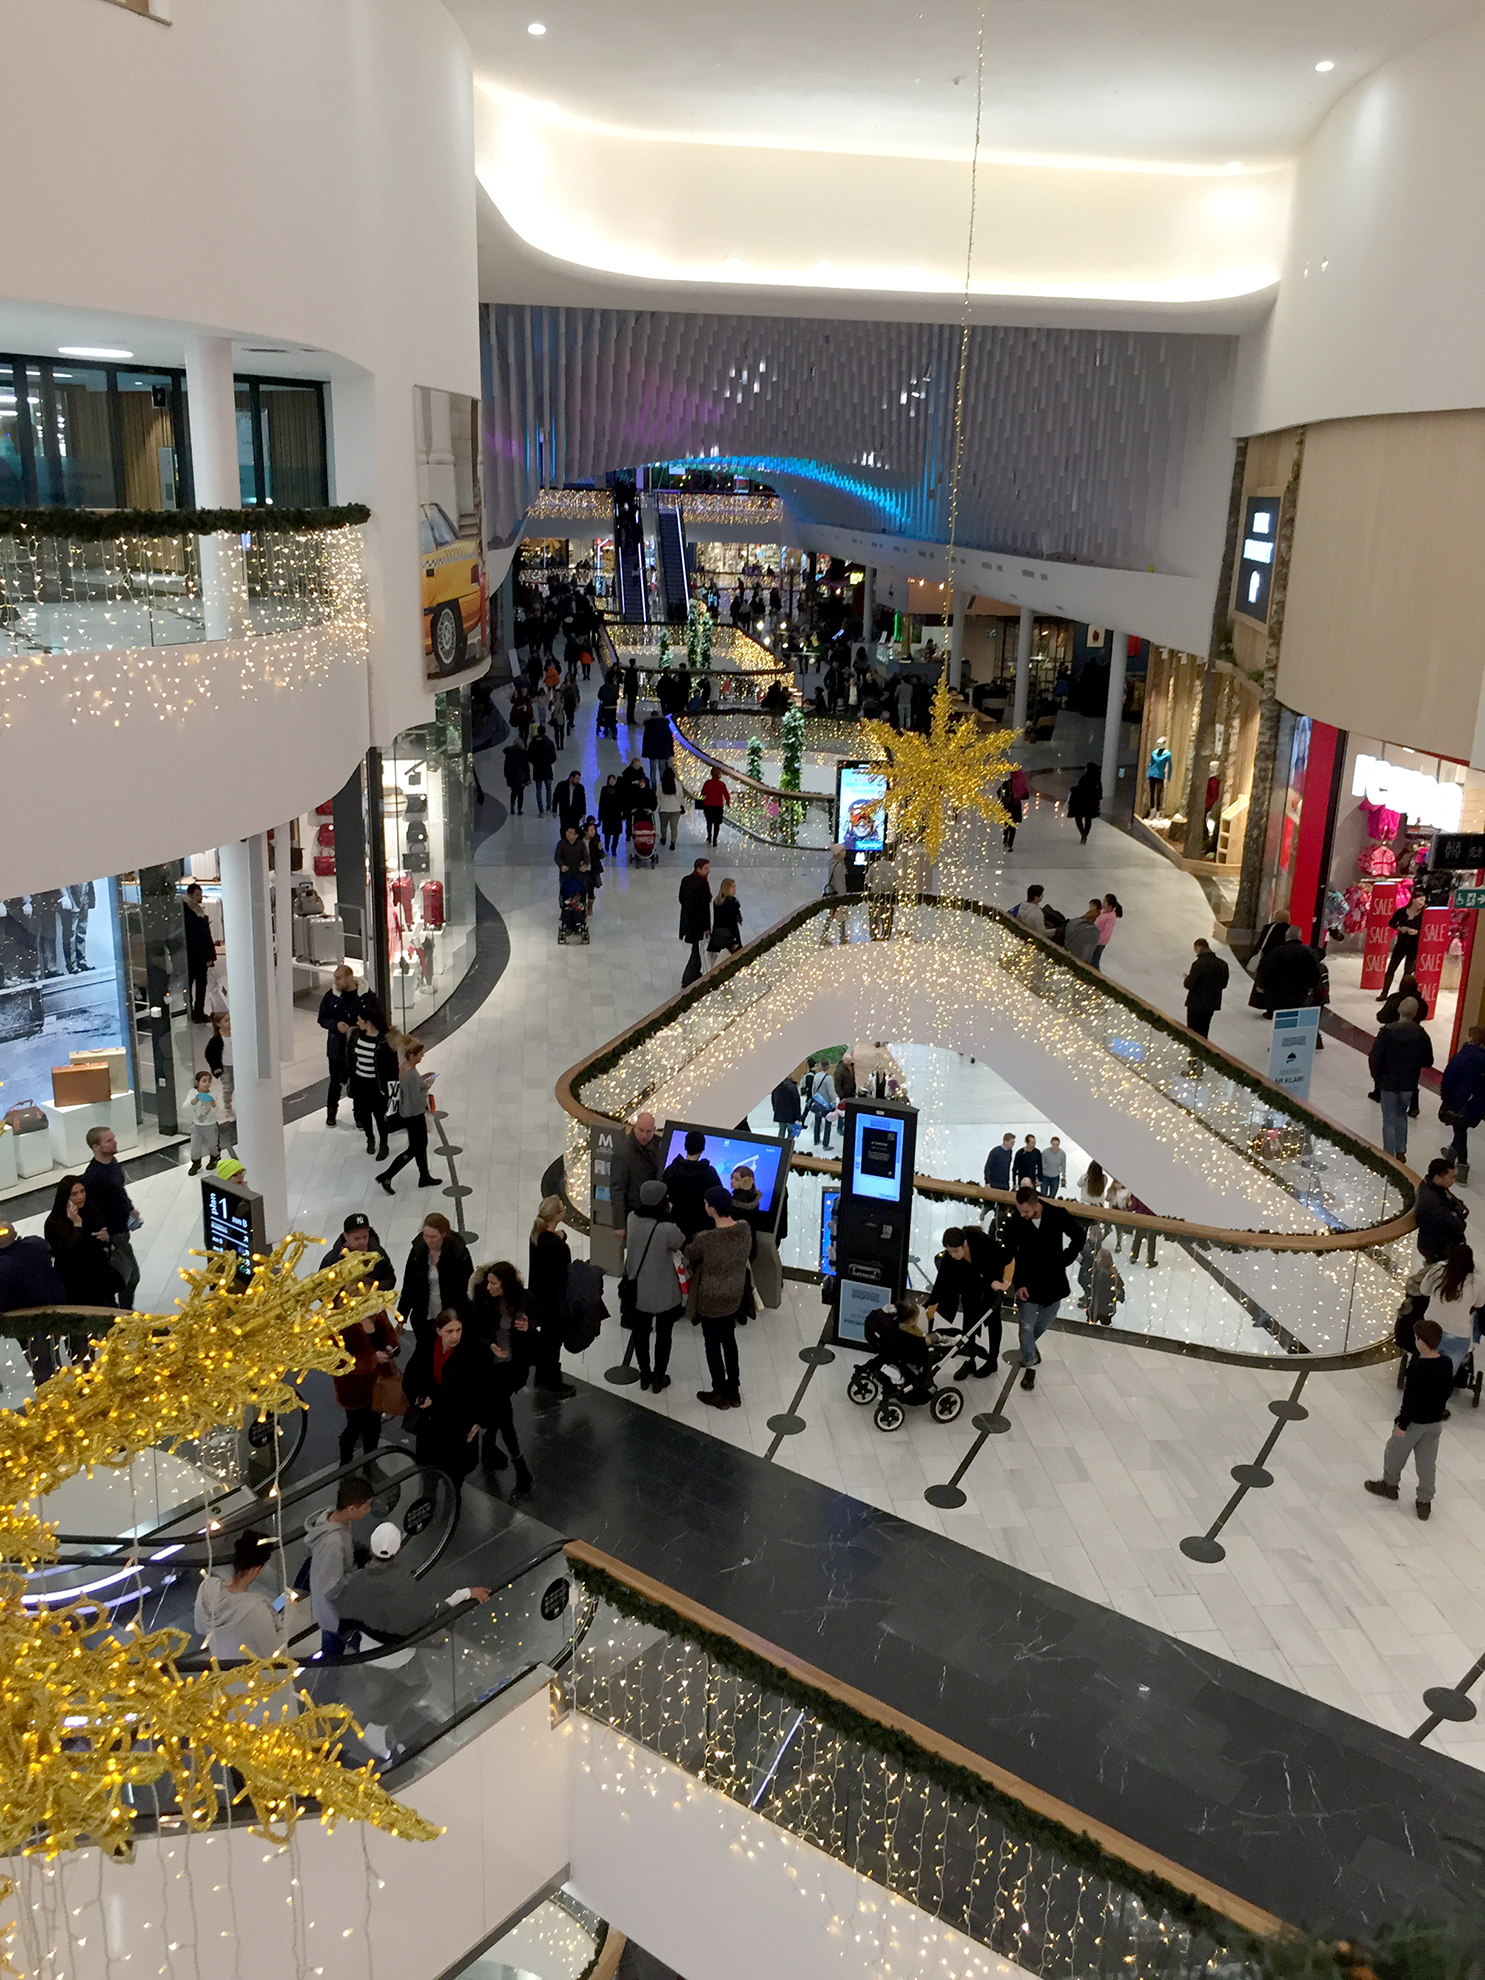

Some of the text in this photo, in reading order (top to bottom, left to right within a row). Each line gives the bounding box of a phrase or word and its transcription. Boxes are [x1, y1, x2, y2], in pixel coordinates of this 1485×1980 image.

[1372, 898, 1394, 916] SALE
[1369, 926, 1390, 944] SALE
[1424, 923, 1447, 942] SALE
[1365, 954, 1386, 972] SALE
[1420, 953, 1442, 972] SALE
[599, 1133, 613, 1148] M
[209, 1192, 219, 1216] plan
[218, 1197, 228, 1219] 1
